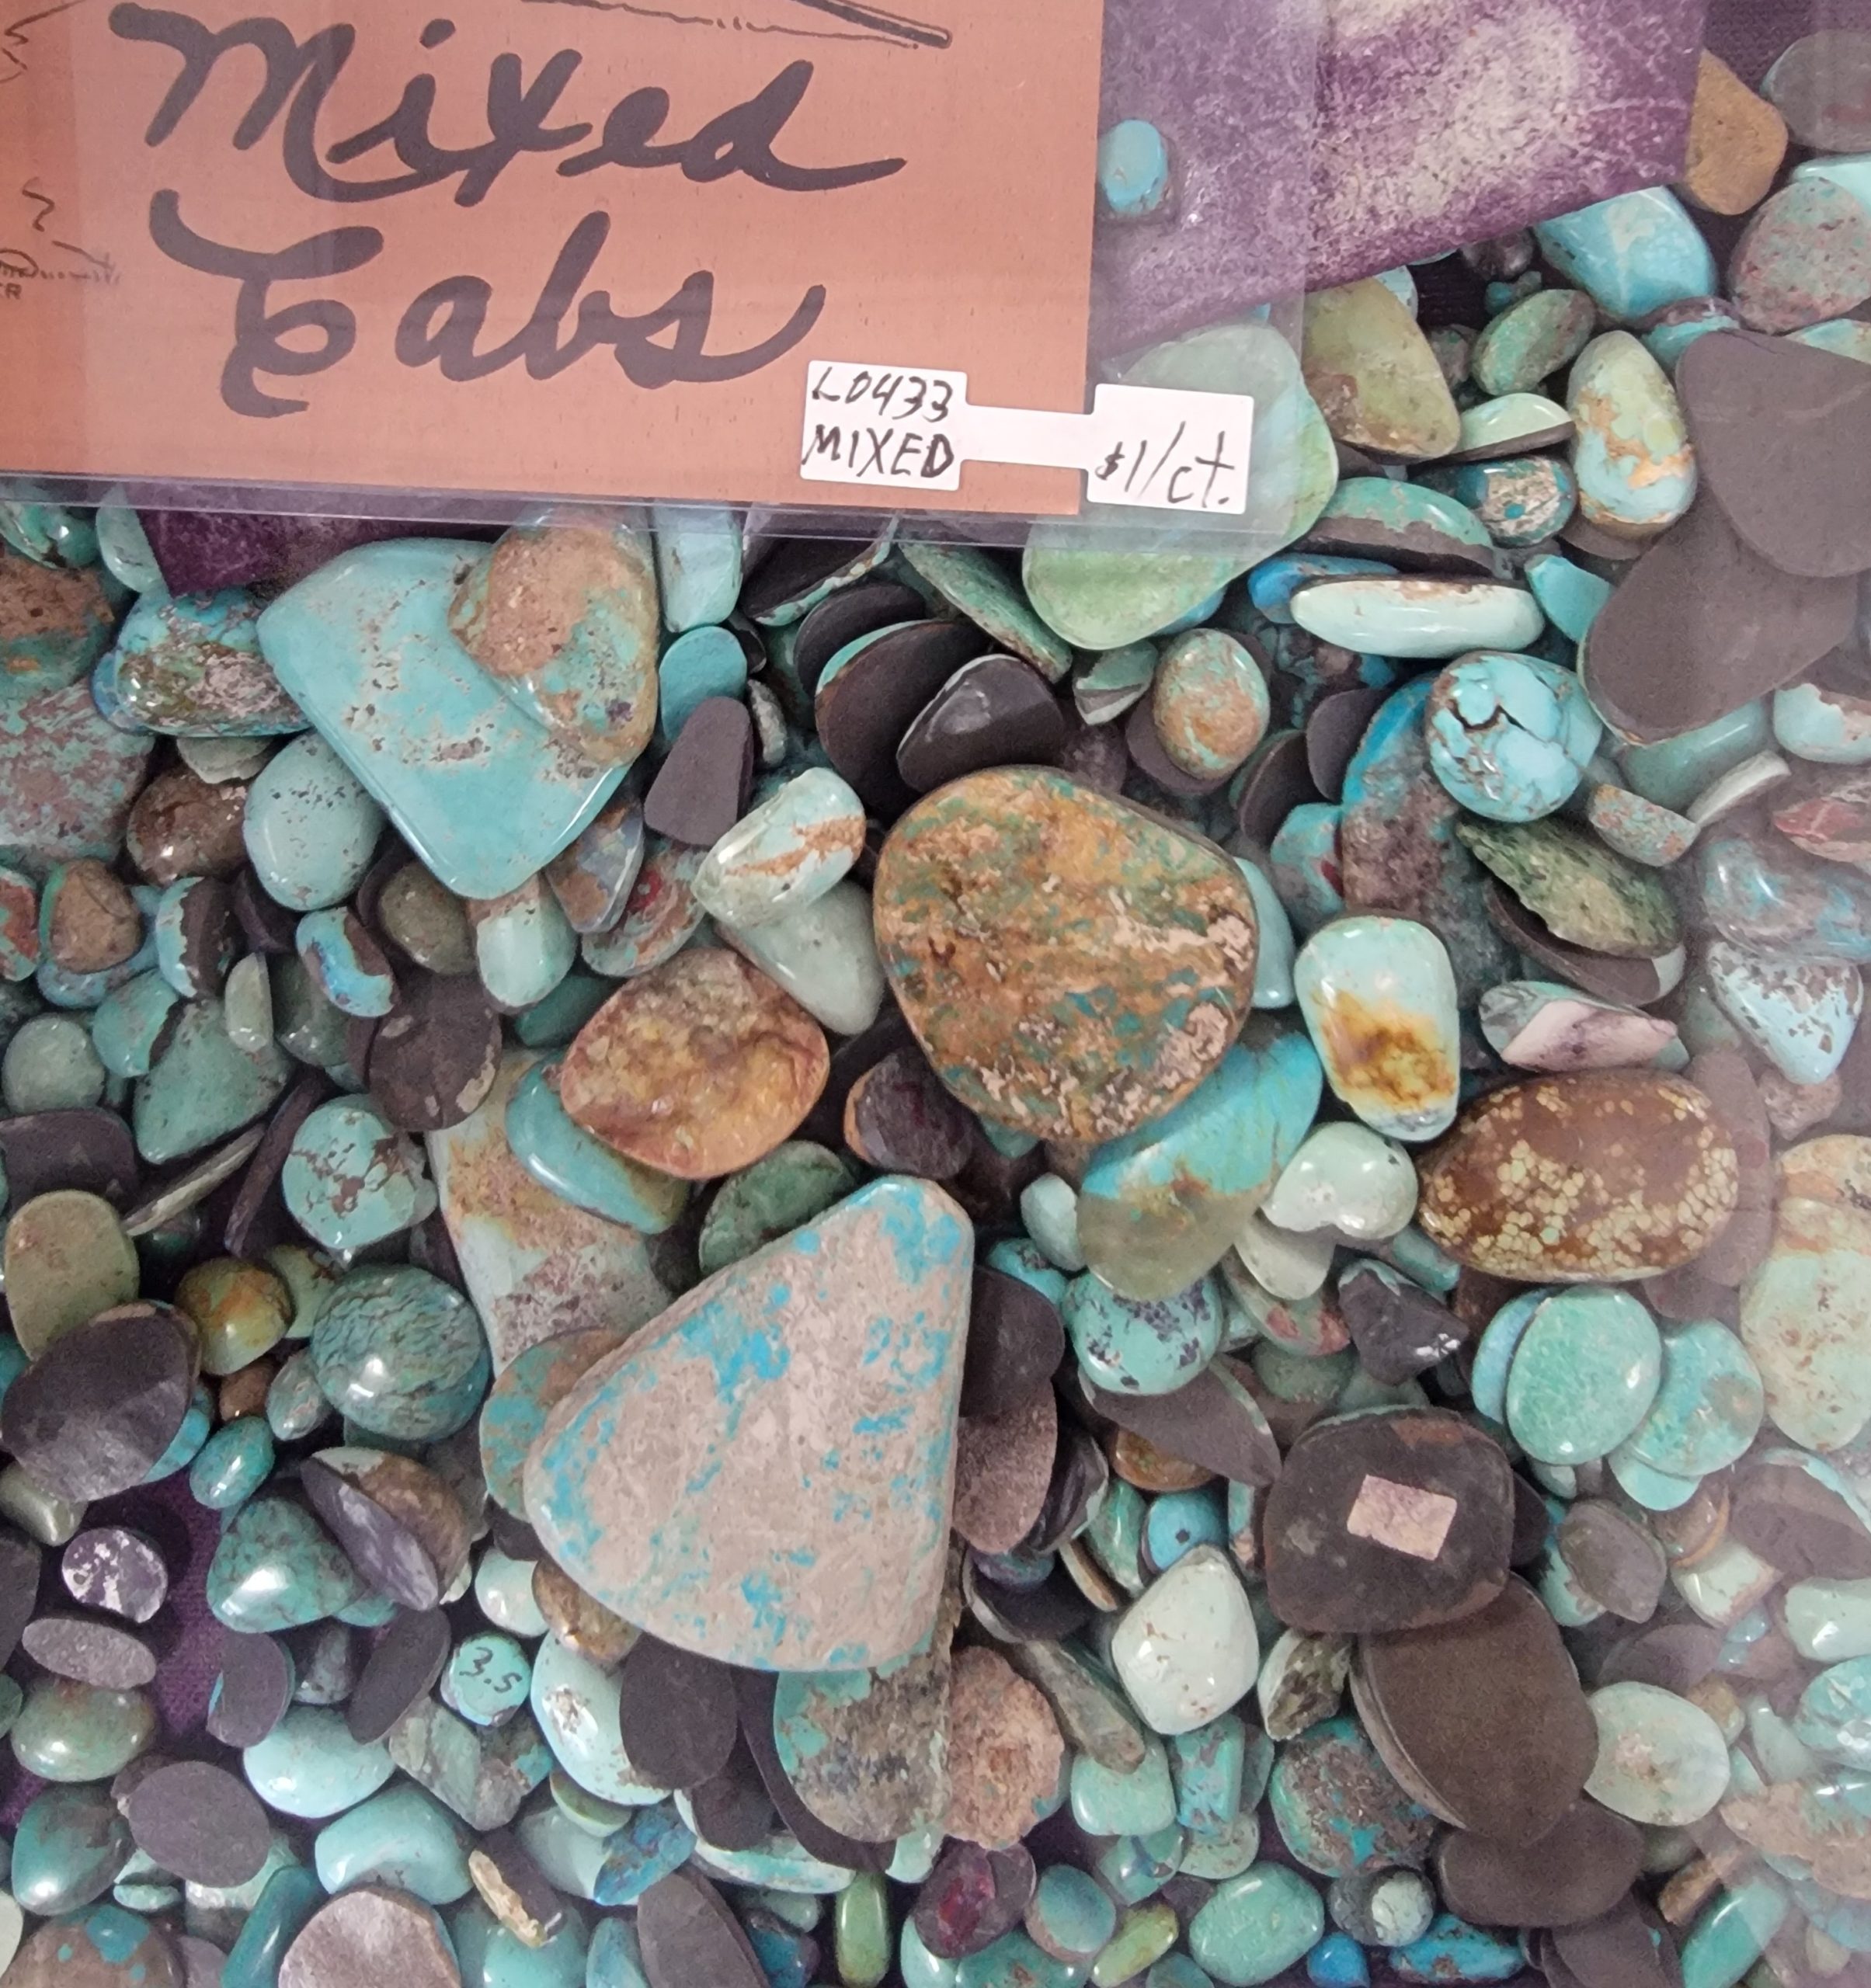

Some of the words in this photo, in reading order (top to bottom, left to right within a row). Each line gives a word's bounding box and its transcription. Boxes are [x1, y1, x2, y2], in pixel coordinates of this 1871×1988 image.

[108, 2, 907, 206] Mixed
[148, 189, 826, 418] Cabs
[801, 422, 955, 478] MIXED
